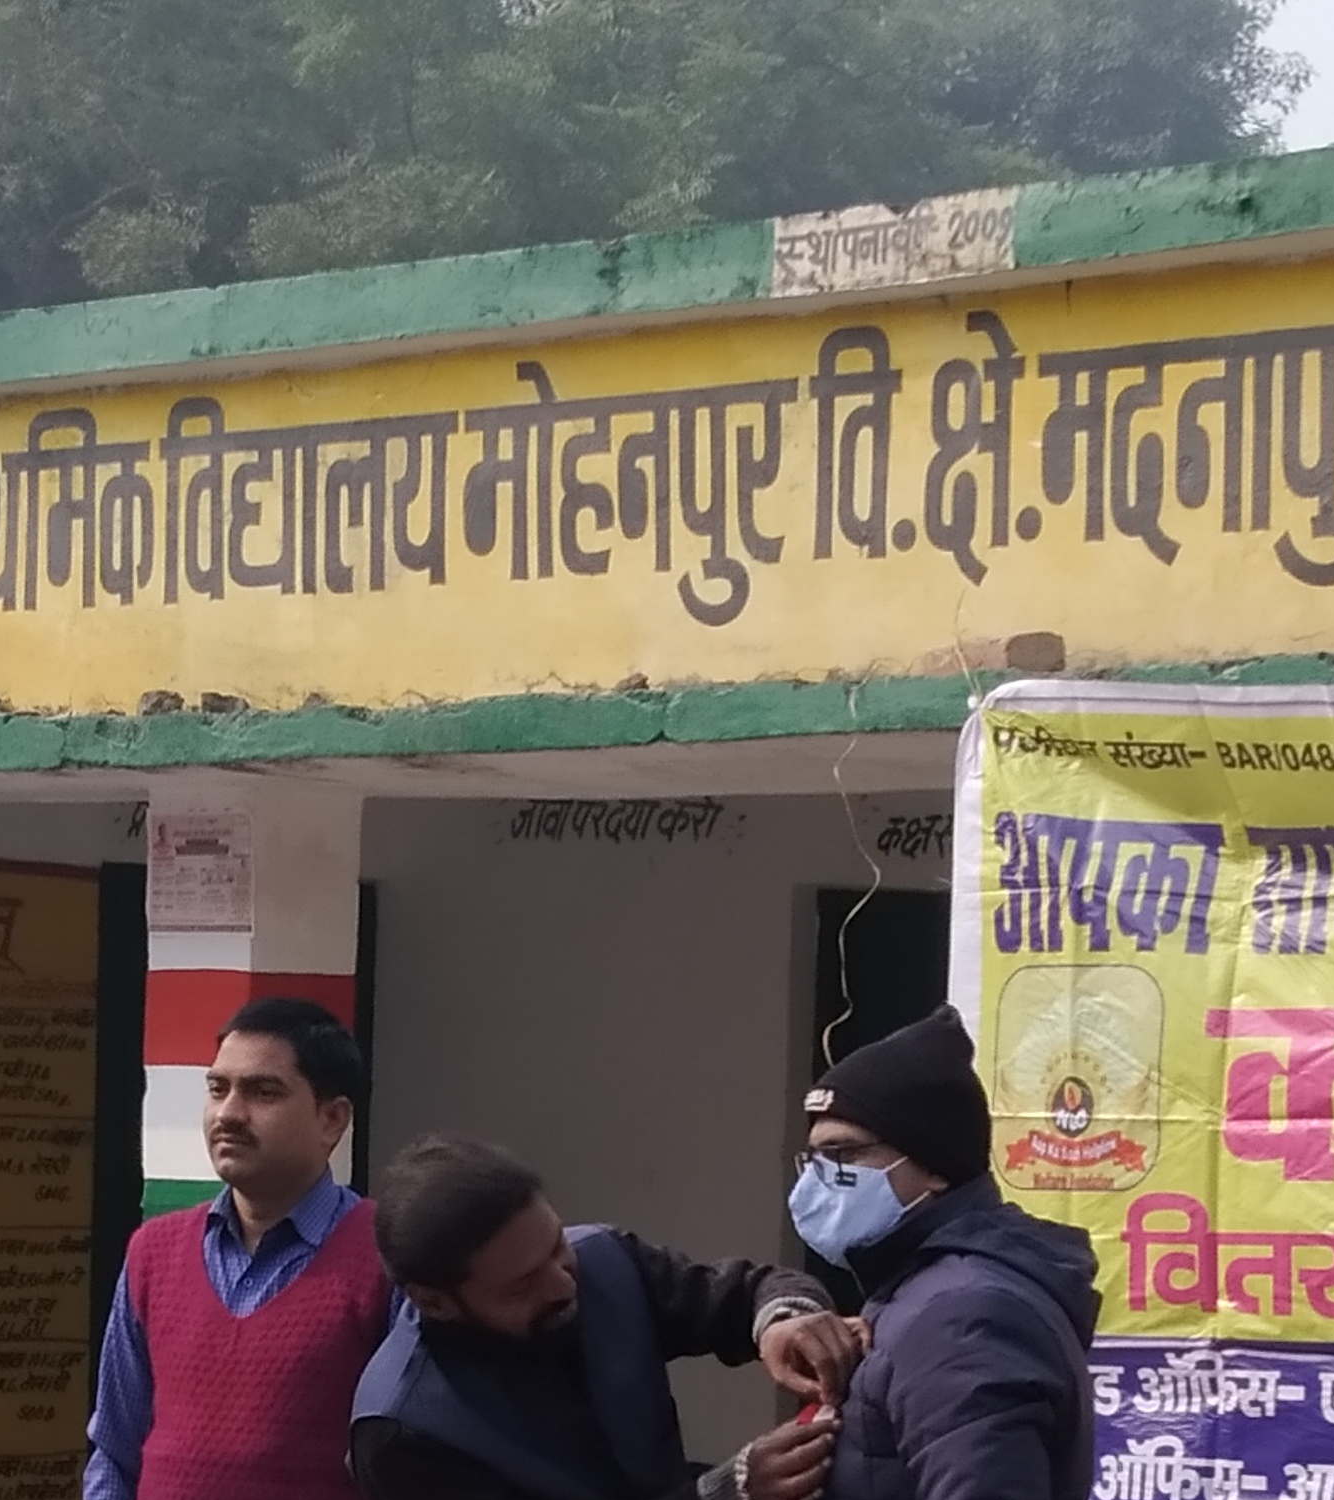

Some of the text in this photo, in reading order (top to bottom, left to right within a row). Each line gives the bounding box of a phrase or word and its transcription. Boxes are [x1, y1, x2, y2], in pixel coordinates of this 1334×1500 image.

[160, 396, 460, 604] विद्यालय
[463, 360, 798, 628] मोहनपुर
[993, 811, 1227, 955] आपका
